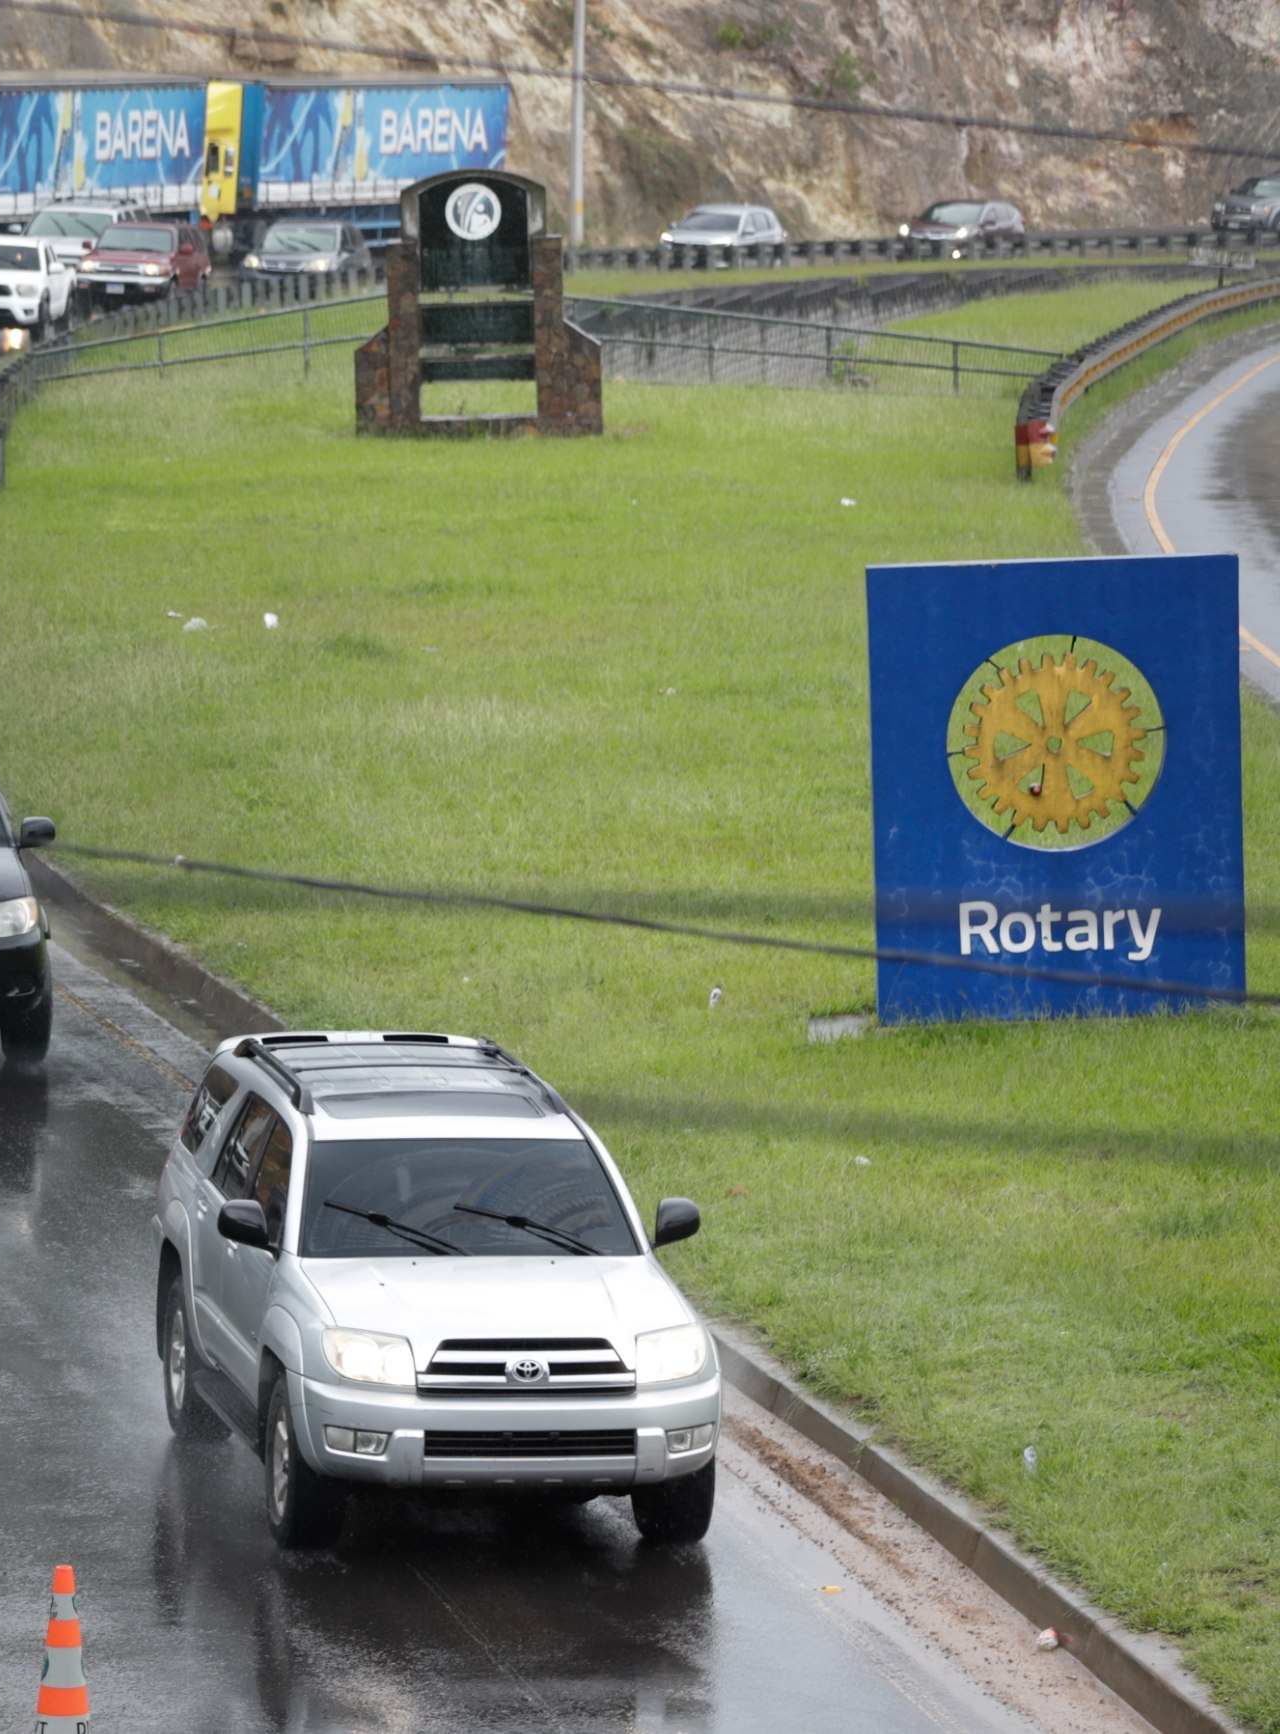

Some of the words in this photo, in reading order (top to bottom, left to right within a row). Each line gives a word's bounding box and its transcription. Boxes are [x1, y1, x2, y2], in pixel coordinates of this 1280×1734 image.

[95, 109, 190, 161] BARENA
[379, 107, 489, 154] BARENA
[959, 901, 1162, 961] Rotary
